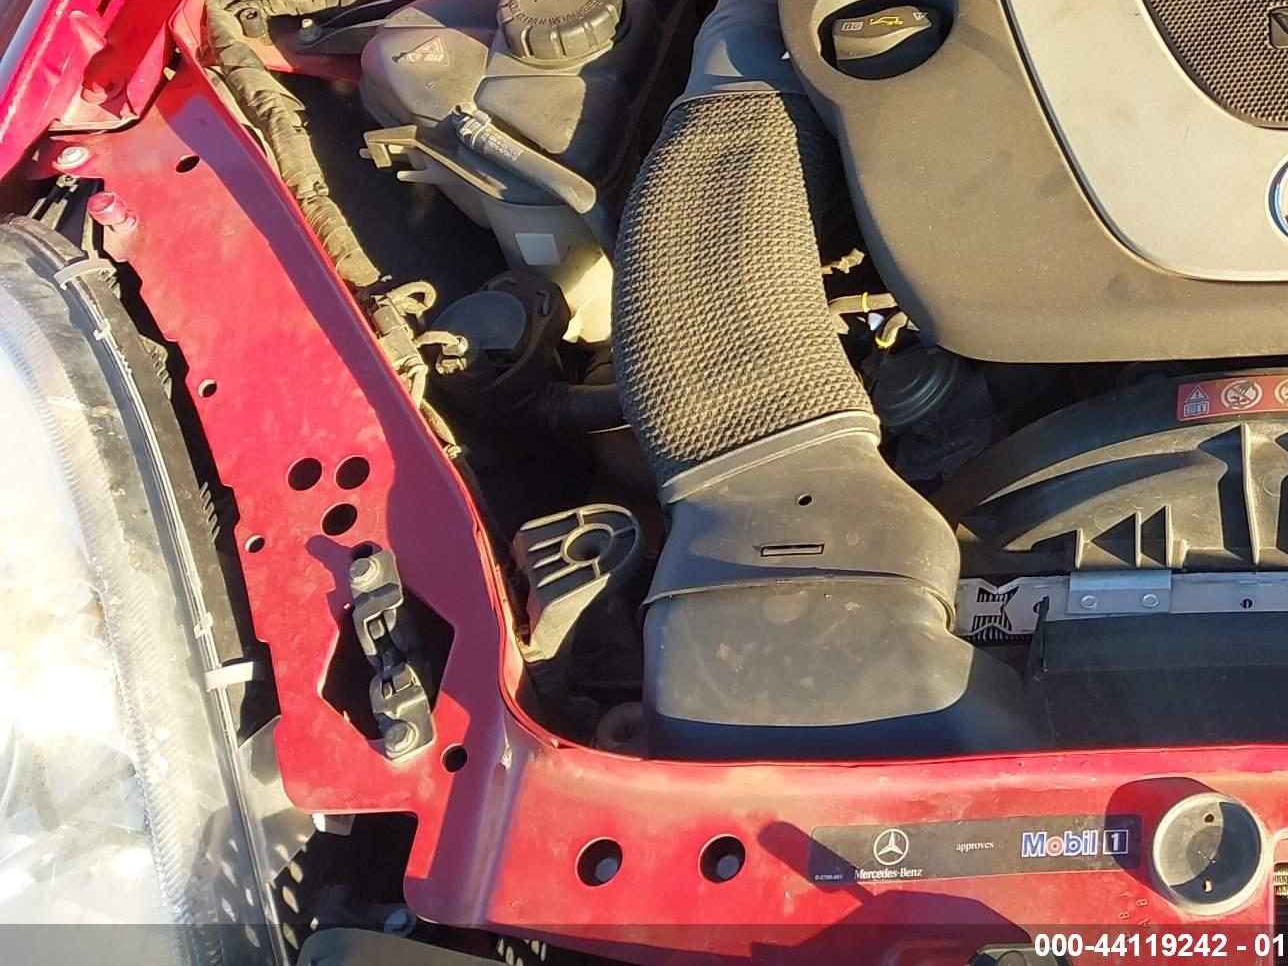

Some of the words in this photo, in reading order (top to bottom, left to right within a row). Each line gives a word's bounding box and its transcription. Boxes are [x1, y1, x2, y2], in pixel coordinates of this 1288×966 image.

[955, 841, 995, 853] approves
[1021, 829, 1099, 858] Mobil
[853, 867, 923, 880] Mercedes-Benz
